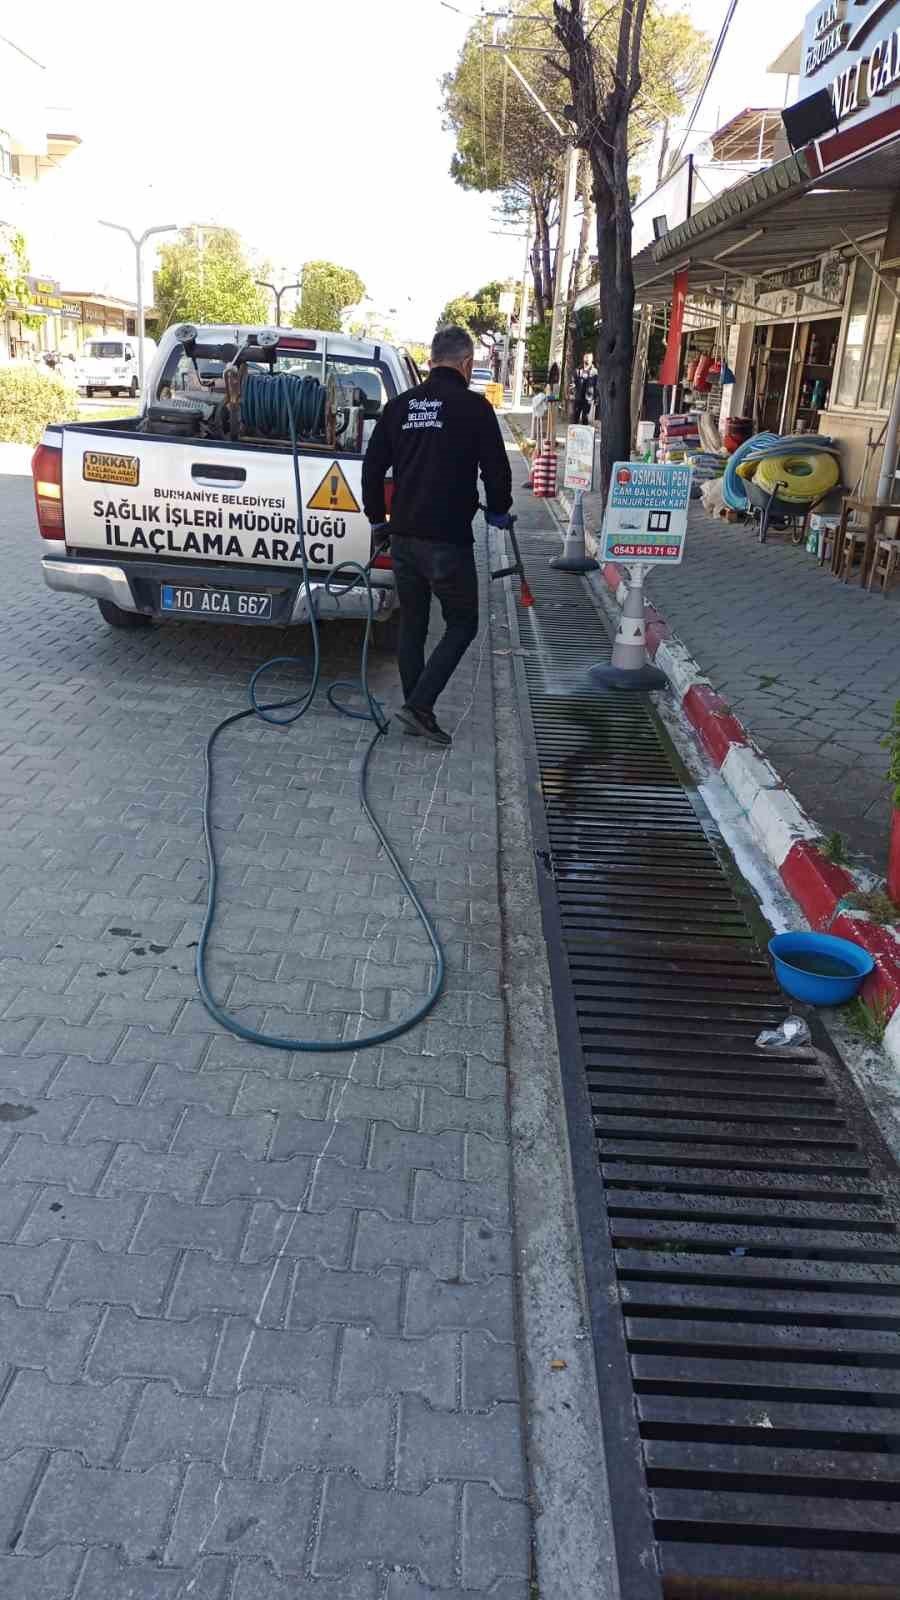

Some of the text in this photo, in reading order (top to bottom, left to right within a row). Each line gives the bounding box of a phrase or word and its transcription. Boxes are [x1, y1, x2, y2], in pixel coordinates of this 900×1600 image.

[631, 470, 689, 487] OSMANLI PEN
[154, 488, 285, 509] BURHANİYE BELEDİYESİ
[93, 499, 346, 538] SAĞLIK İŞLERİ MÜDÜRLÜĞÜ
[105, 519, 334, 565] İLAÇLAMA ARACI
[175, 590, 269, 615] 10 ACA 667
